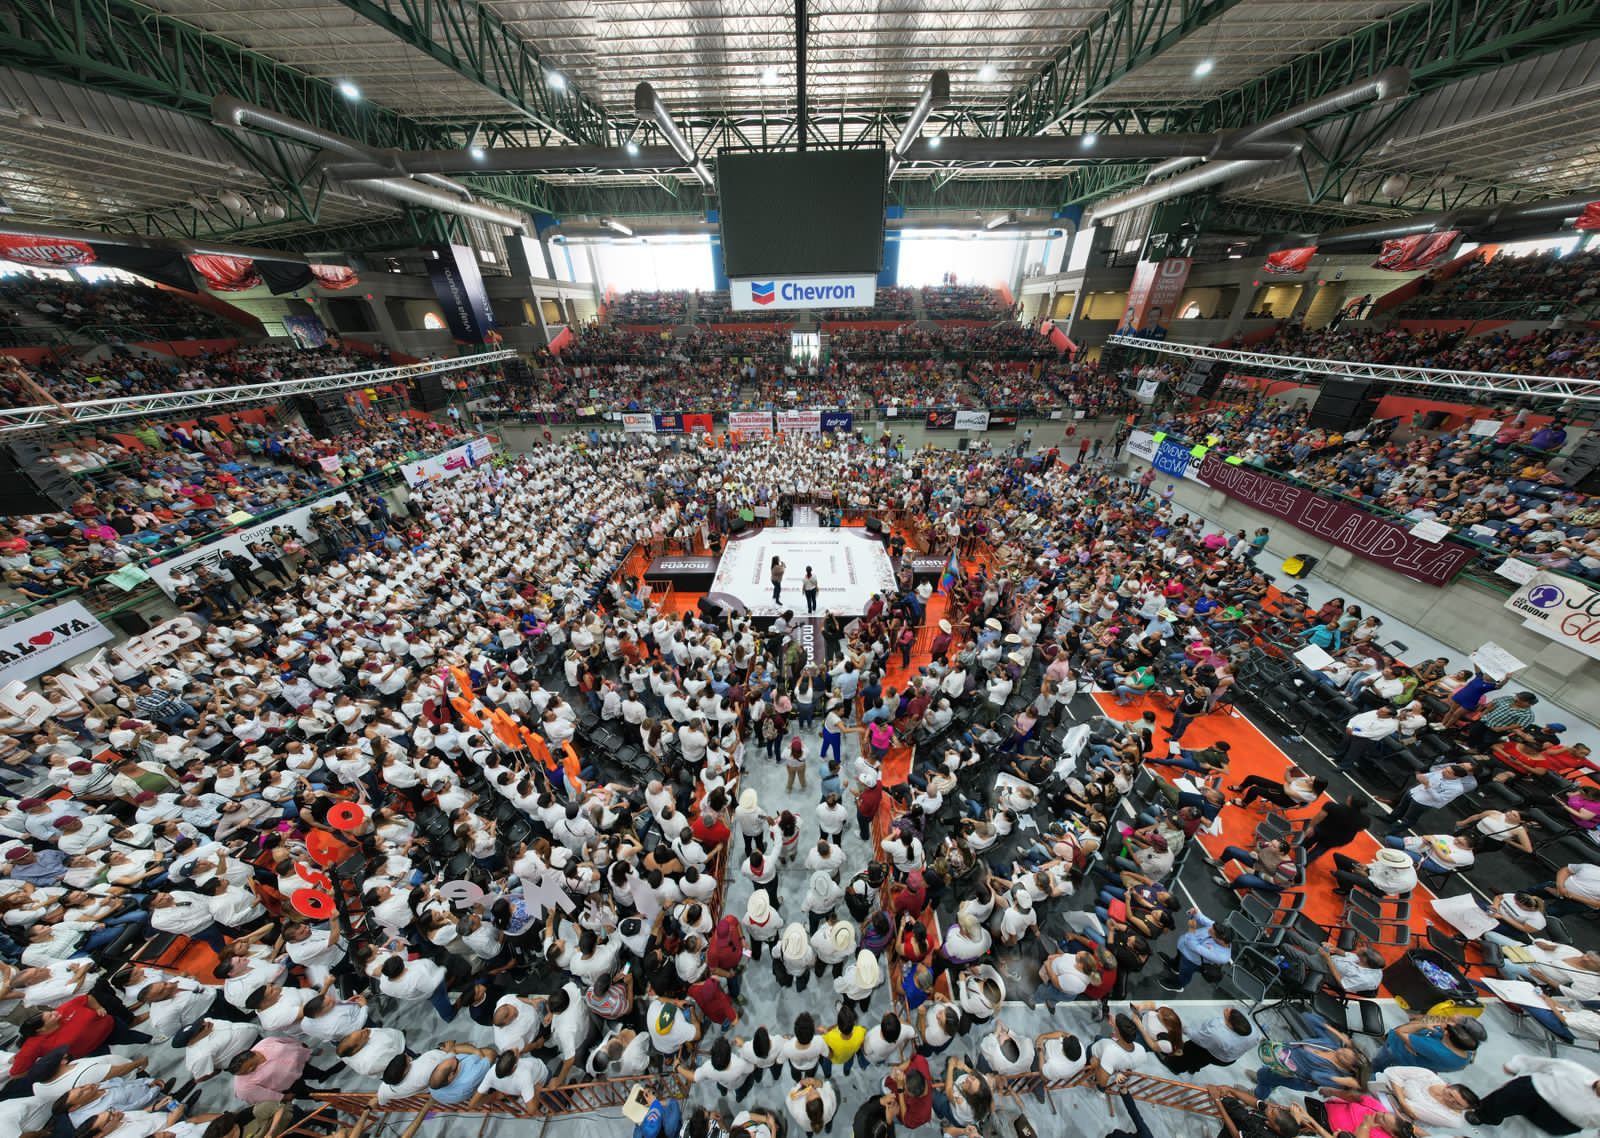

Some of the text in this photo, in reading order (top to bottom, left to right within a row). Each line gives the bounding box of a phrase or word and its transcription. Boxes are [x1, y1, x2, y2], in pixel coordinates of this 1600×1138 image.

[781, 282, 855, 301] Chevron
[1201, 456, 1466, 581] JOVENES CLAUDIA
[239, 525, 271, 543] Grupo
[1512, 600, 1550, 621] CLAUDIA
